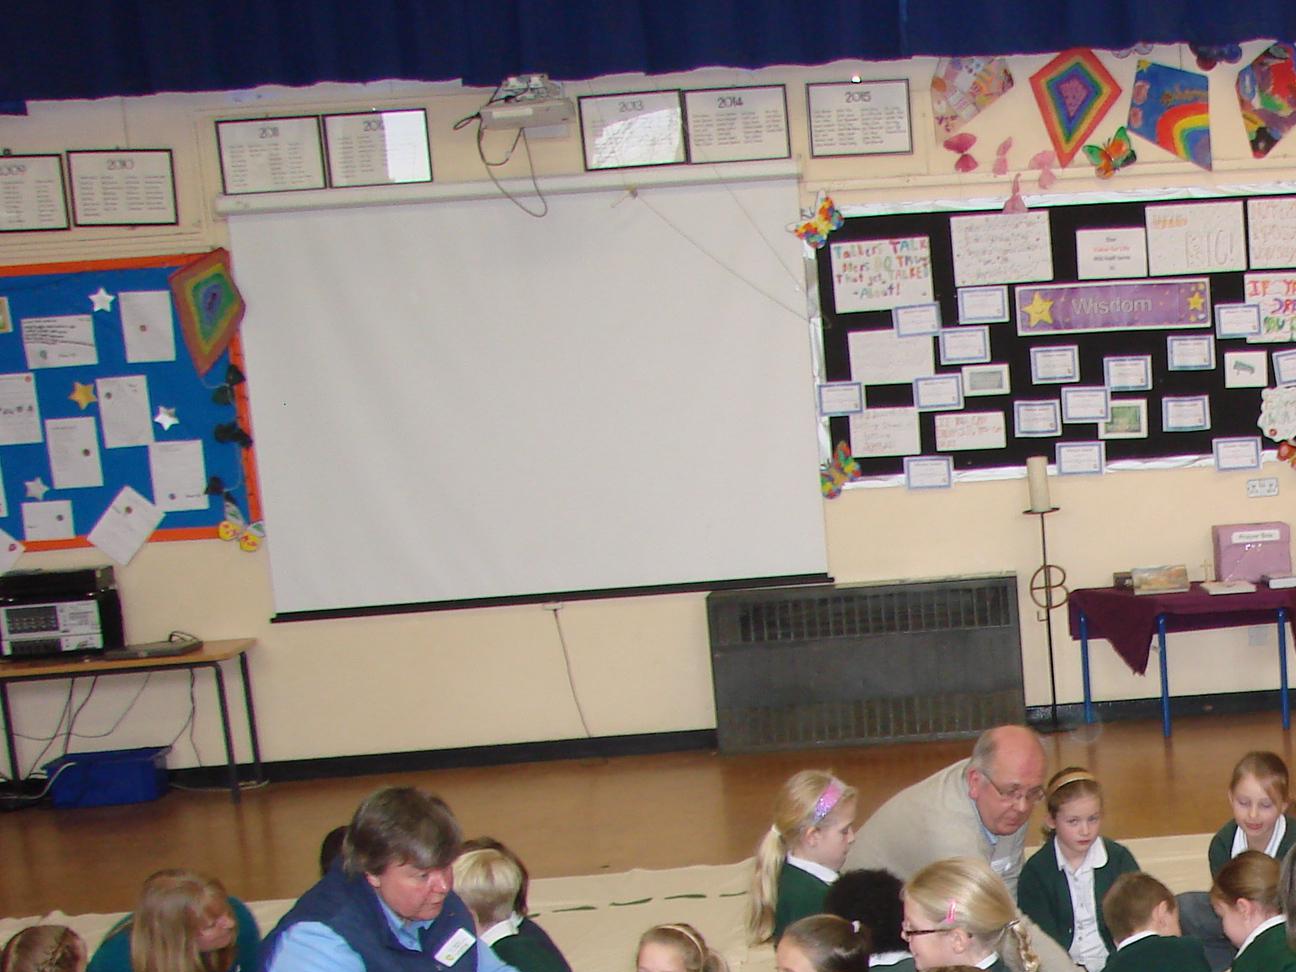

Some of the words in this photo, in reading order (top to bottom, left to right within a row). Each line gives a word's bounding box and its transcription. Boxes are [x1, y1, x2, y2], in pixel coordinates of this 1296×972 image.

[717, 96, 744, 109] 2014
[845, 91, 873, 104] 2015
[618, 100, 644, 113] 2013
[362, 119, 385, 132] 201
[106, 159, 134, 171] 2010
[888, 239, 928, 255] TALK
[1071, 296, 1152, 315] Wisdom
